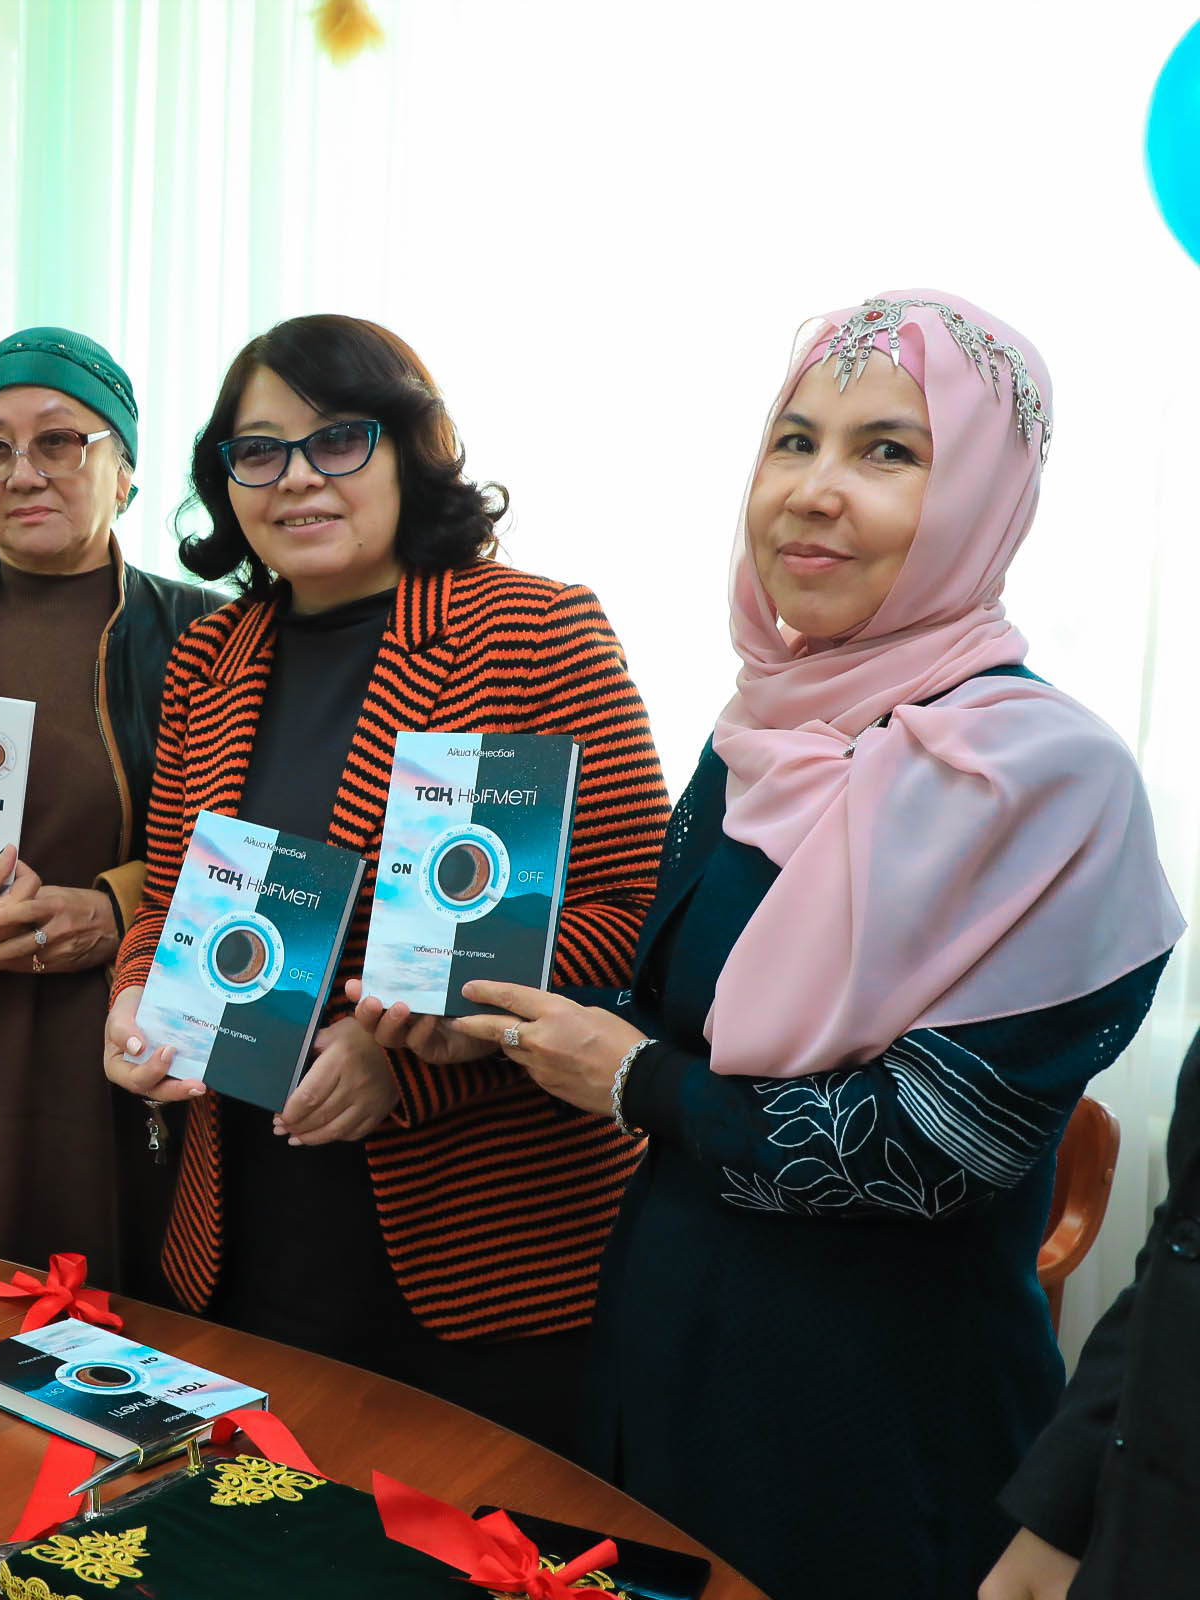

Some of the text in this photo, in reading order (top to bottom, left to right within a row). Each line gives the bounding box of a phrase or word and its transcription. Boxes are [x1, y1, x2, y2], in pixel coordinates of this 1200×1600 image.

[391, 862, 412, 875] ON
[517, 870, 545, 883] OFF
[173, 932, 194, 947] ON
[288, 967, 314, 984] OFF
